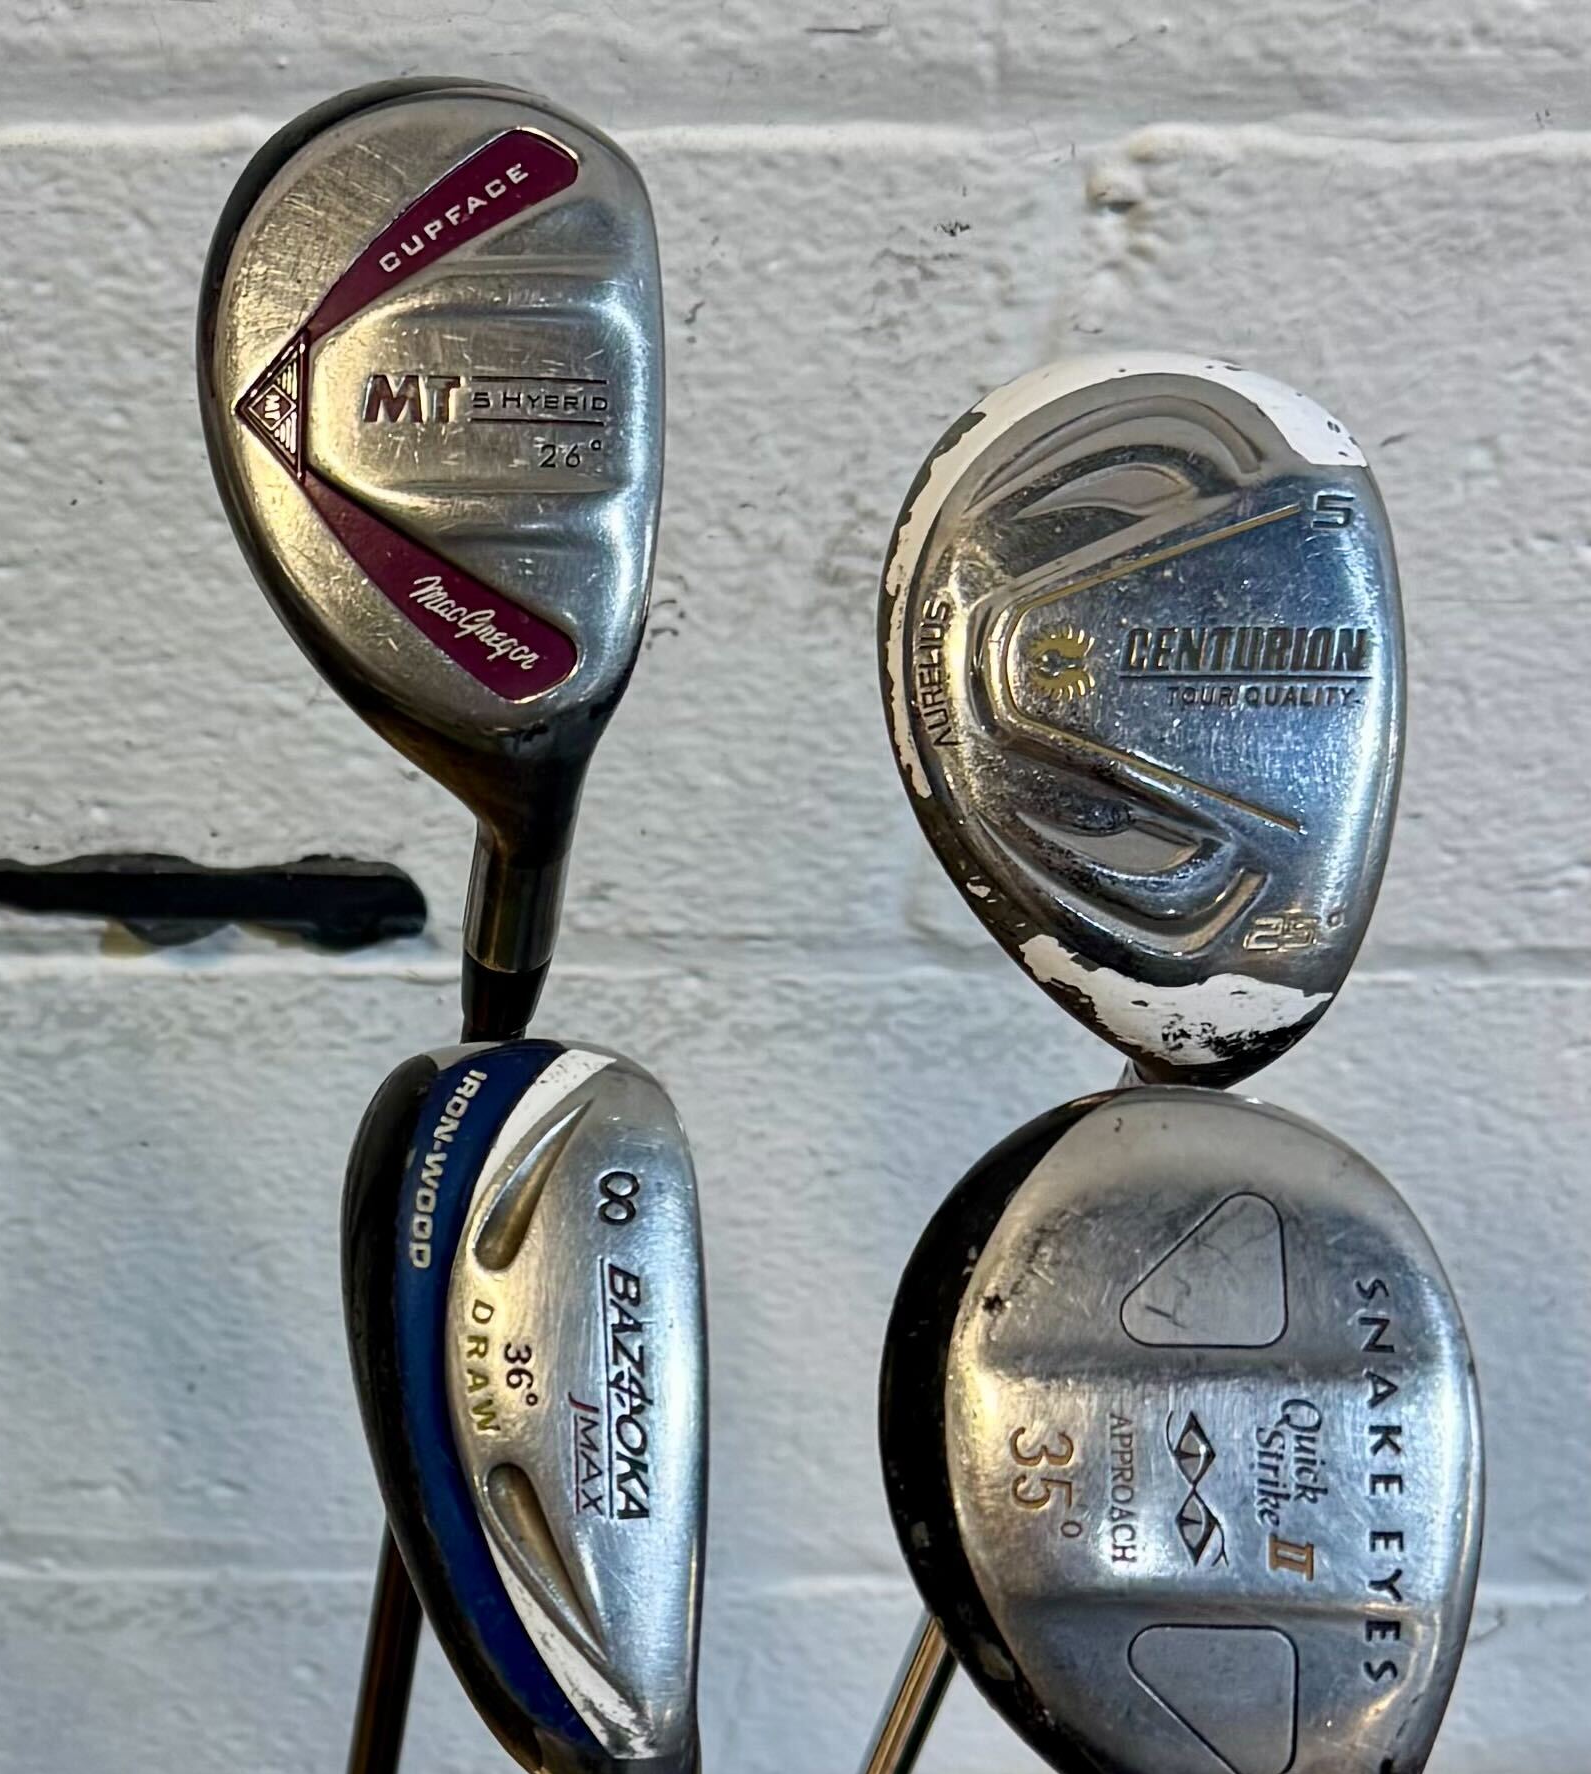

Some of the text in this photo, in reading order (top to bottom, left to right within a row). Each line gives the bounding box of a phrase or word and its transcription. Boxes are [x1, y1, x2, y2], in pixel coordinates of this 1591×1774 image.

[379, 163, 529, 272] CUPFACE
[363, 374, 461, 424] MT
[502, 391, 608, 411] HYBRID
[540, 439, 602, 468] 26°
[1311, 493, 1357, 530] 5
[413, 574, 539, 672] MacGregor
[919, 600, 963, 746] AURELIUS
[1120, 627, 1371, 672] CENTURION
[1166, 686, 1357, 708] TOUR QUALITY
[409, 1069, 488, 1269] IRON-WOOD
[598, 1169, 638, 1227] 8
[465, 1299, 502, 1436] DRAW
[502, 1341, 539, 1408] 36°
[608, 1262, 653, 1520] BAZOOKA
[1010, 1426, 1081, 1539] 35°
[1108, 1412, 1138, 1564] APPROACH
[1255, 1427, 1282, 1527] Strike
[1279, 1398, 1328, 1504] Quick
[1353, 1278, 1403, 1682] SNAKE EYES
